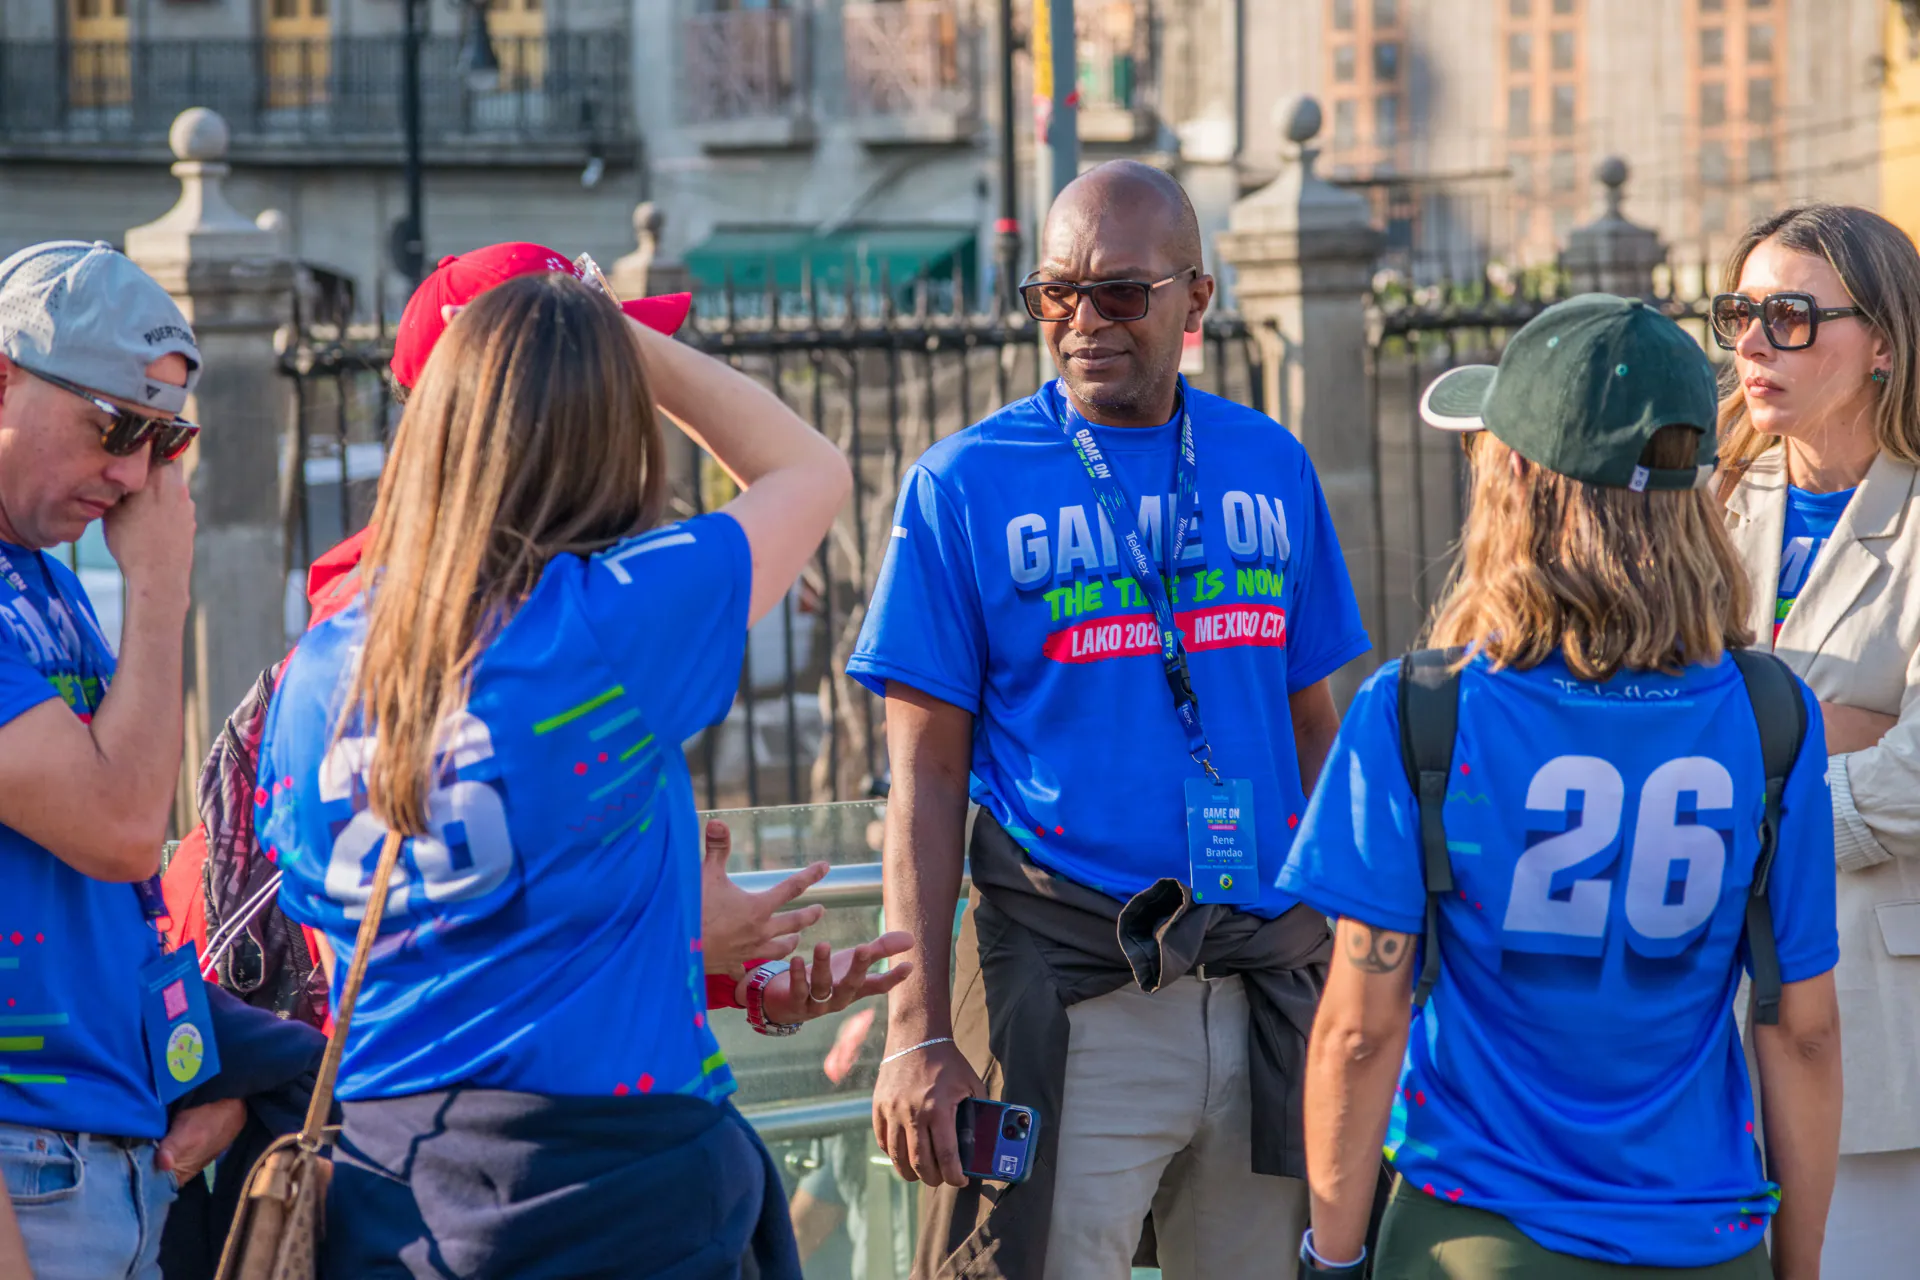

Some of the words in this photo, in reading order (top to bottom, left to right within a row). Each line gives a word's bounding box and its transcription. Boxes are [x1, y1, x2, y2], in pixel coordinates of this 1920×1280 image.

[1076, 429, 1103, 462] GAME
[1093, 463, 1111, 479] ON
[1173, 517, 1188, 560] Teleflex
[1222, 490, 1291, 561] ON
[1126, 530, 1150, 576] Teleflex
[1042, 580, 1104, 621] THE
[1113, 574, 1181, 608] TIE
[1193, 568, 1225, 603] IS
[1237, 568, 1284, 597] NOW
[1071, 623, 1121, 657] LAKO
[1195, 611, 1260, 644] MEXICO
[1260, 611, 1286, 639] CIT
[1164, 631, 1174, 660] LET'S
[1203, 807, 1227, 819] GAME
[1229, 807, 1240, 819] ON
[1206, 847, 1243, 857] Brandao
[1213, 835, 1235, 845] Rene
[1502, 755, 1734, 940] 26
